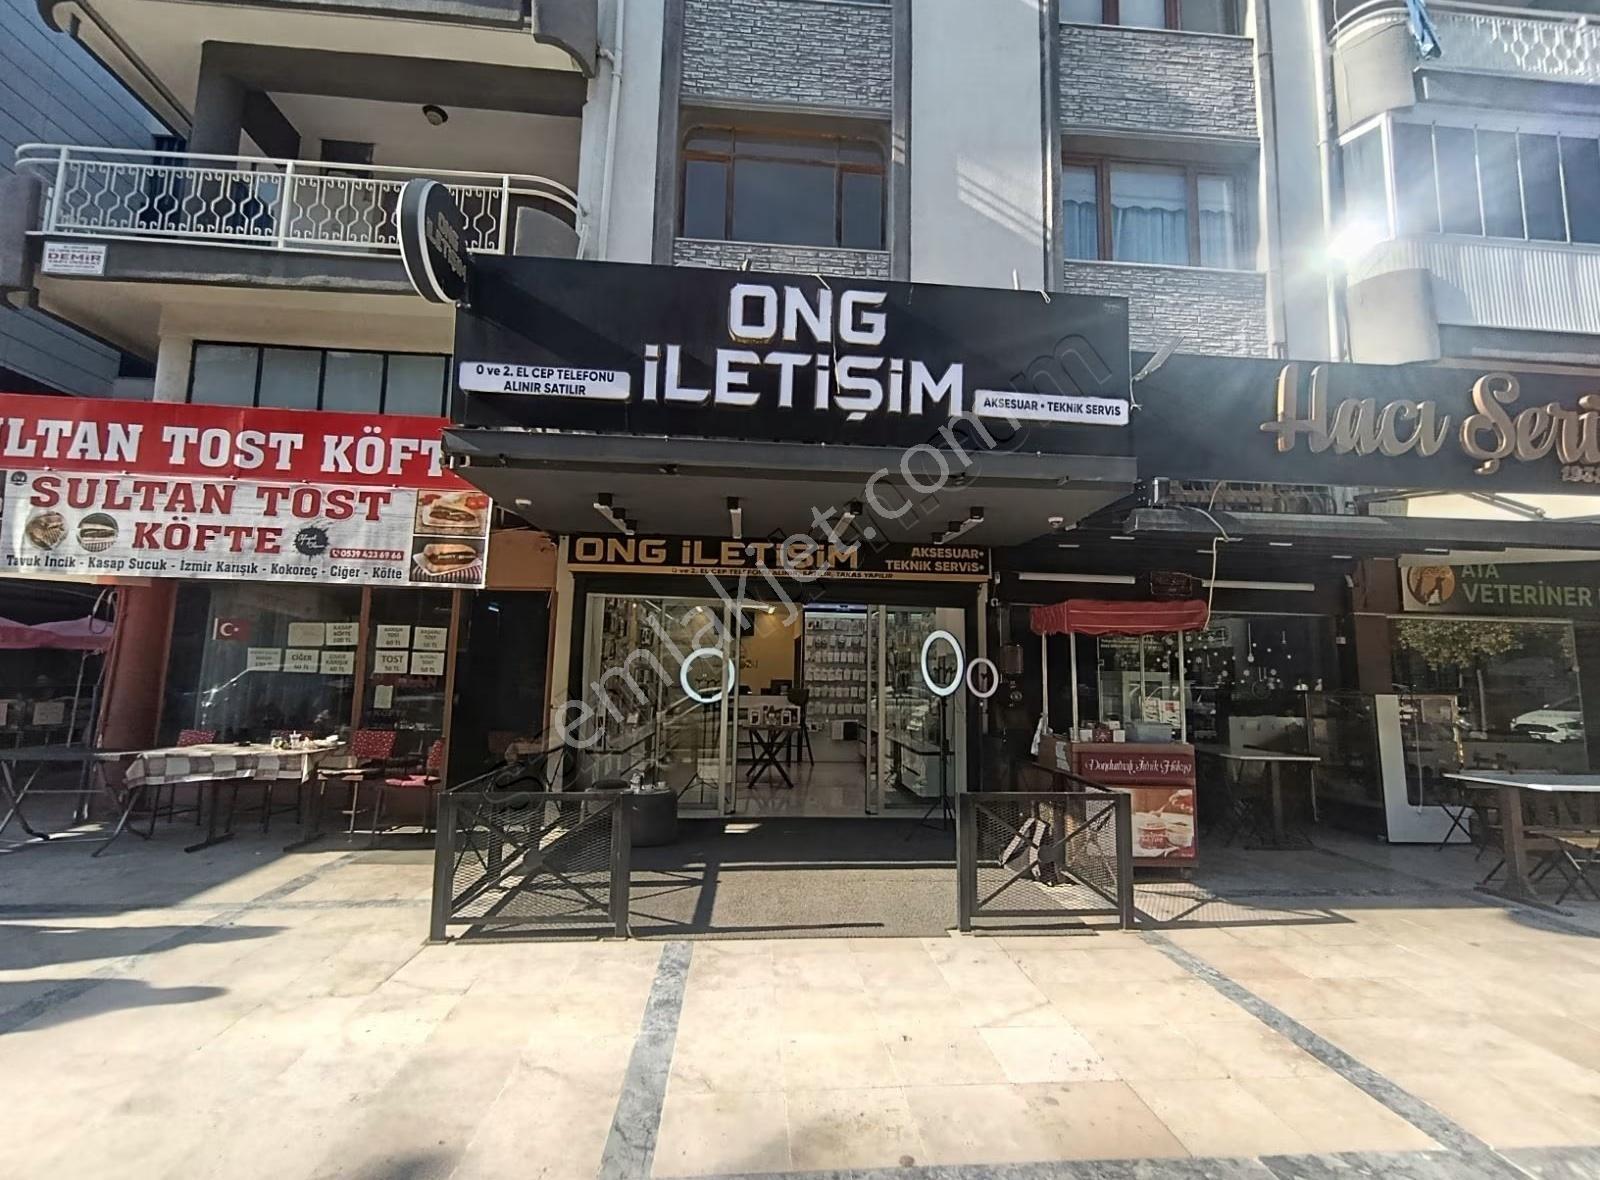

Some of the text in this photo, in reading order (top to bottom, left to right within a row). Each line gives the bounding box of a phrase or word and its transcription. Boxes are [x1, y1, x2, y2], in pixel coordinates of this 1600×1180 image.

[729, 282, 887, 346] ONG
[487, 367, 500, 376] ve
[503, 366, 513, 377] 2.
[516, 367, 529, 378] EL
[531, 367, 554, 379] CEP
[557, 369, 615, 382] TELEFONU
[642, 343, 963, 421] İLETİŞİM
[503, 381, 586, 395] ALINIR SATILIR
[983, 398, 1121, 416] AKSESUAR TEKNİK SERVİS
[1259, 363, 1450, 457] Hacı
[0, 417, 443, 477] LTAN TOST KÖFT
[29, 476, 392, 521] SULTAN TOST
[131, 516, 283, 554] KÖFTE
[6, 554, 41, 567] Tavuk
[87, 556, 125, 571] Kasap
[129, 558, 167, 571] Sucuk
[180, 556, 212, 572] İzmir
[215, 559, 258, 576] Karışık
[270, 562, 318, 578] Kokoreç
[330, 564, 360, 579] Ciğer
[372, 565, 402, 579] Köfte
[575, 537, 858, 569] ONG İLETİŞİM
[885, 559, 979, 572] TEKNİK SERVİS
[911, 547, 979, 559] AKSESUAR
[1461, 580, 1592, 607] VETERİNER
[382, 655, 403, 663] TOST
